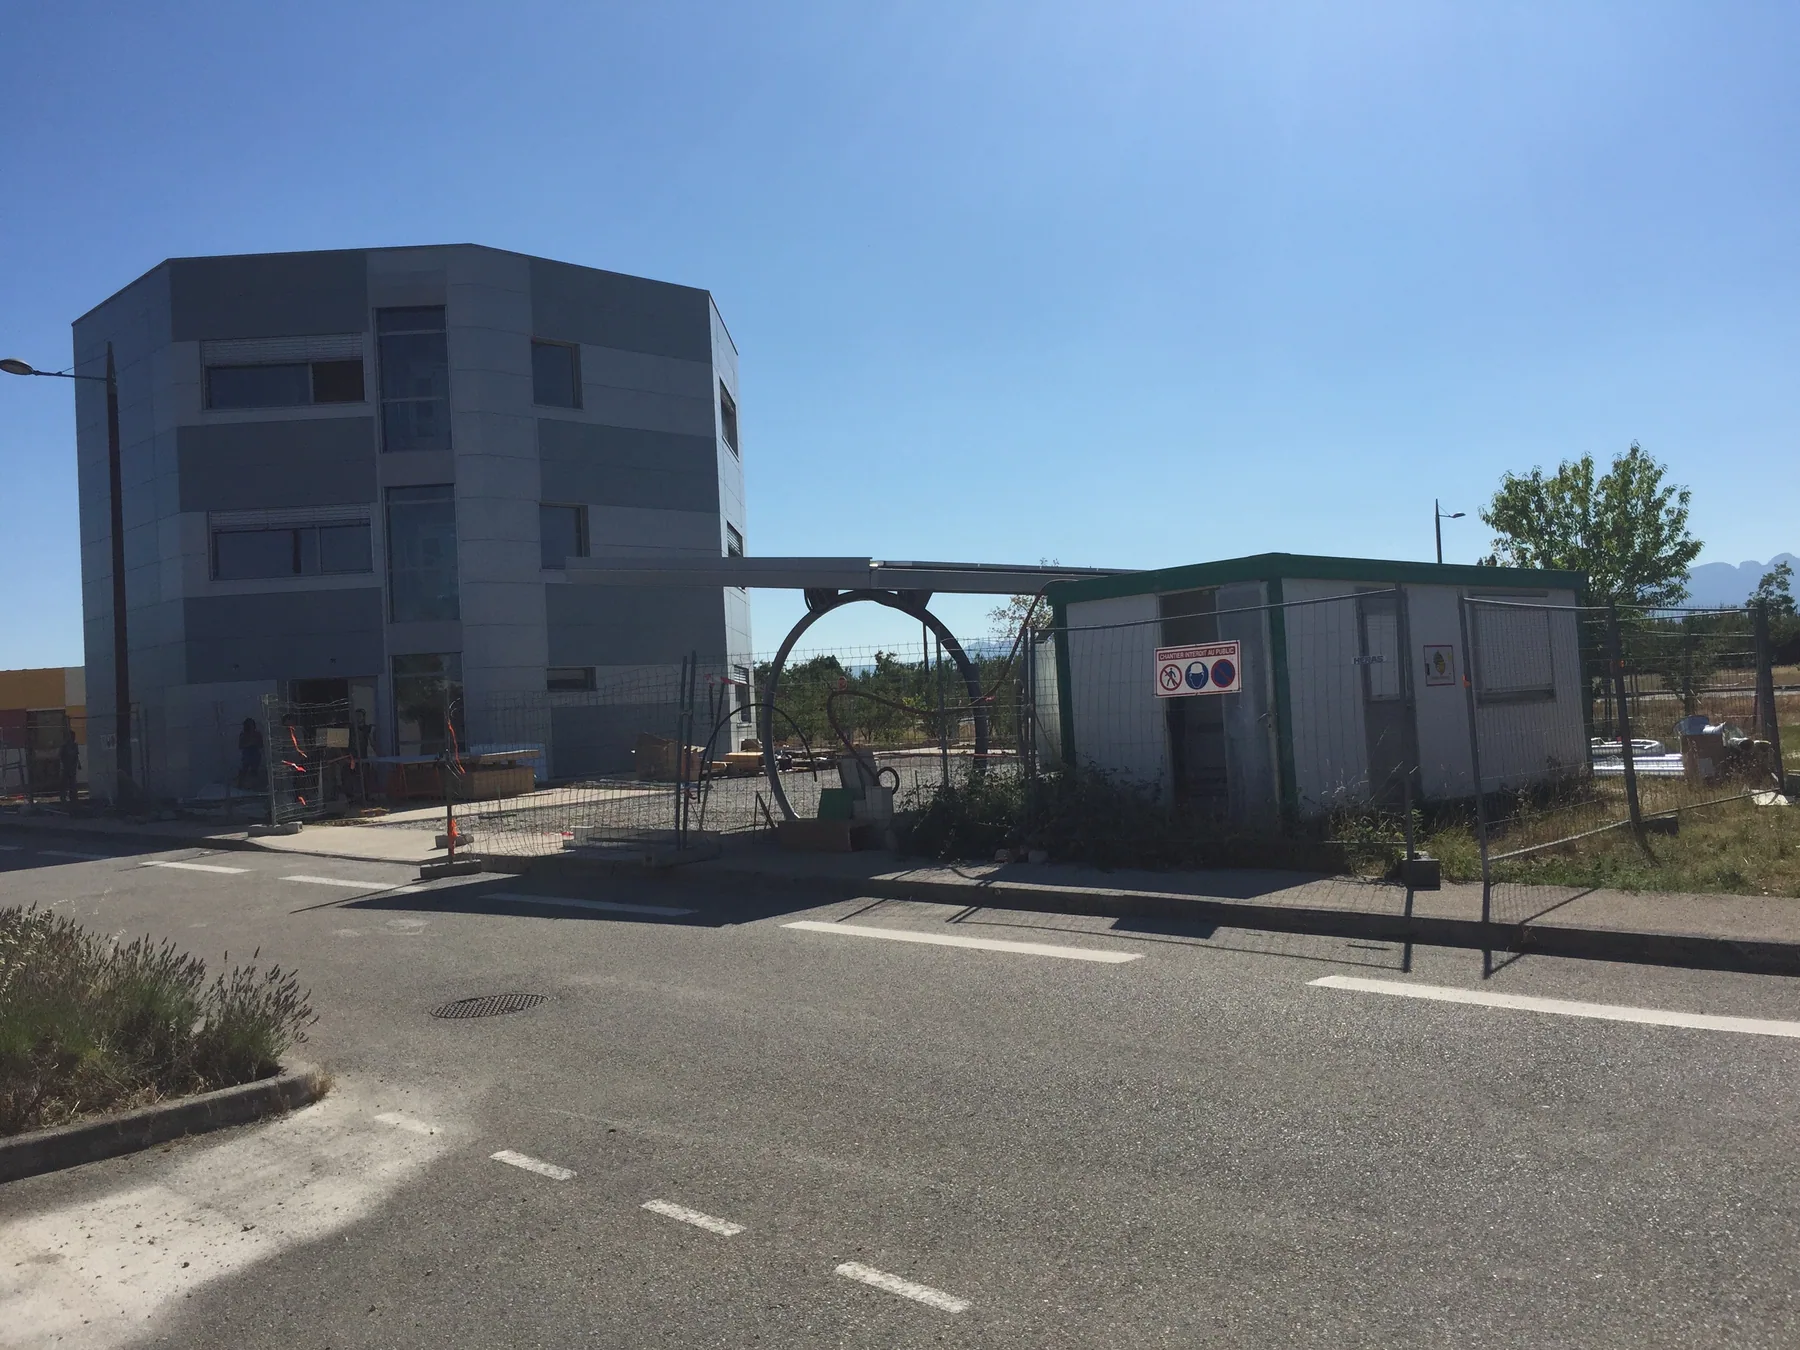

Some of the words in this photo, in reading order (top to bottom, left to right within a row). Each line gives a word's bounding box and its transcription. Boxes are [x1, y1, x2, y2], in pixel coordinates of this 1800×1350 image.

[1159, 652, 1184, 660] CHANTIER
[1185, 650, 1206, 658] INTERDIT
[1216, 647, 1234, 655] PUBLIC
